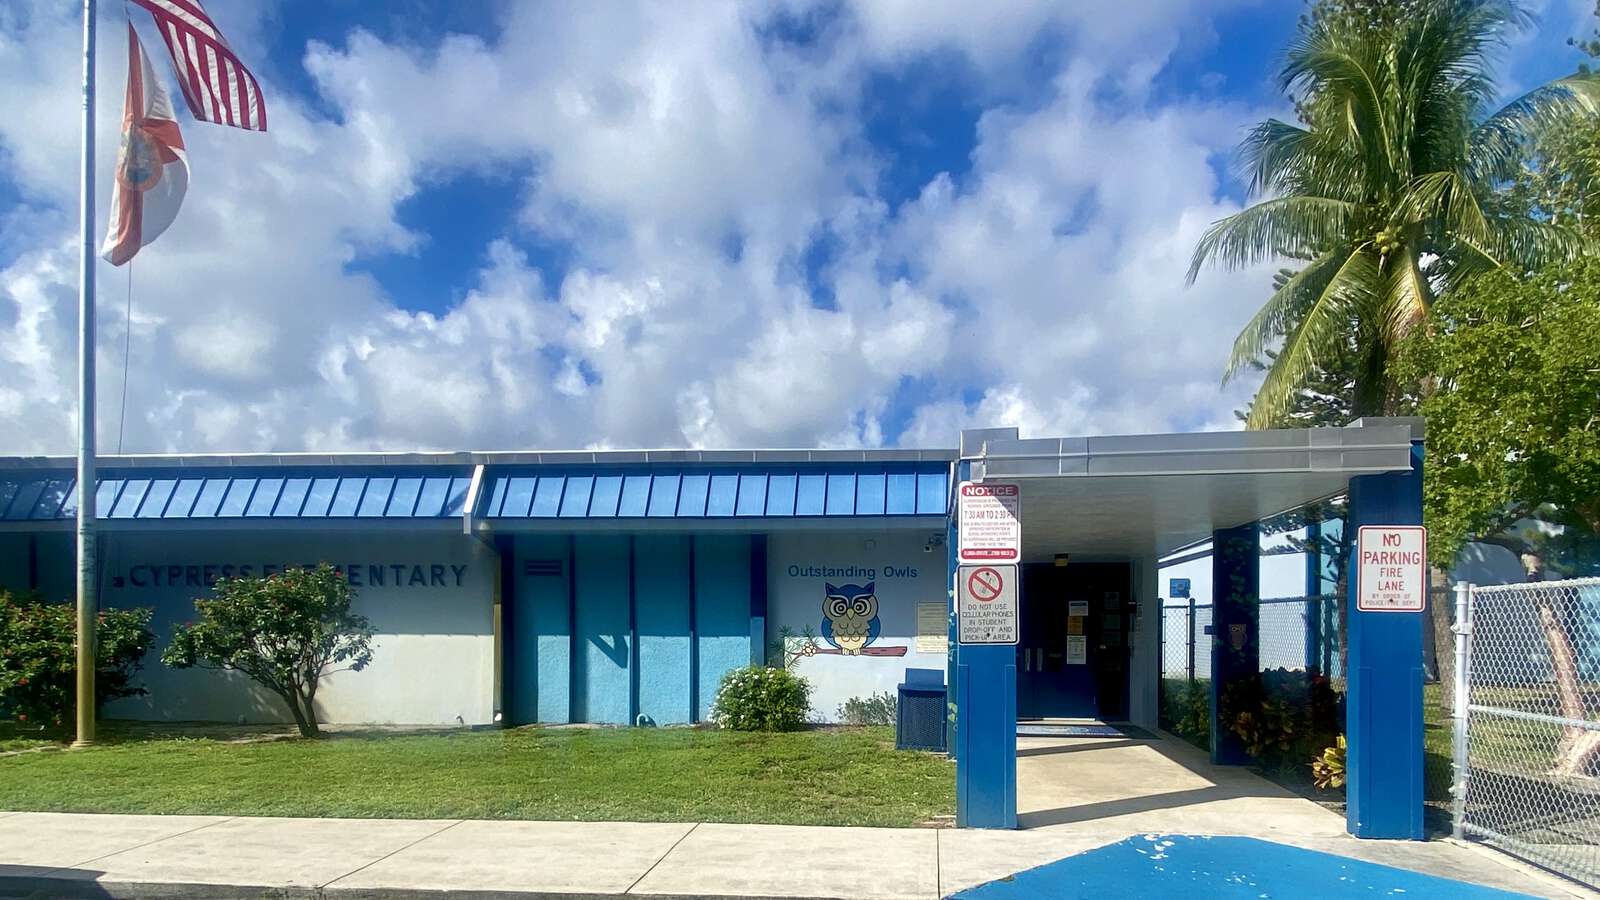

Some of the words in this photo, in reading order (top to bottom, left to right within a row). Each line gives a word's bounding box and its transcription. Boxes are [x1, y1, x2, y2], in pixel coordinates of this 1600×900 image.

[966, 486, 1013, 496] NOTICE
[986, 510, 994, 520] TO
[1383, 533, 1401, 547] NO
[1363, 551, 1420, 565] PARKING
[129, 564, 253, 587] CYPRESS
[263, 564, 467, 587] EENTARY
[788, 565, 876, 580] Outstanding
[883, 565, 918, 578] Owls
[1380, 567, 1403, 577] FIRE
[1378, 581, 1405, 591] LANE
